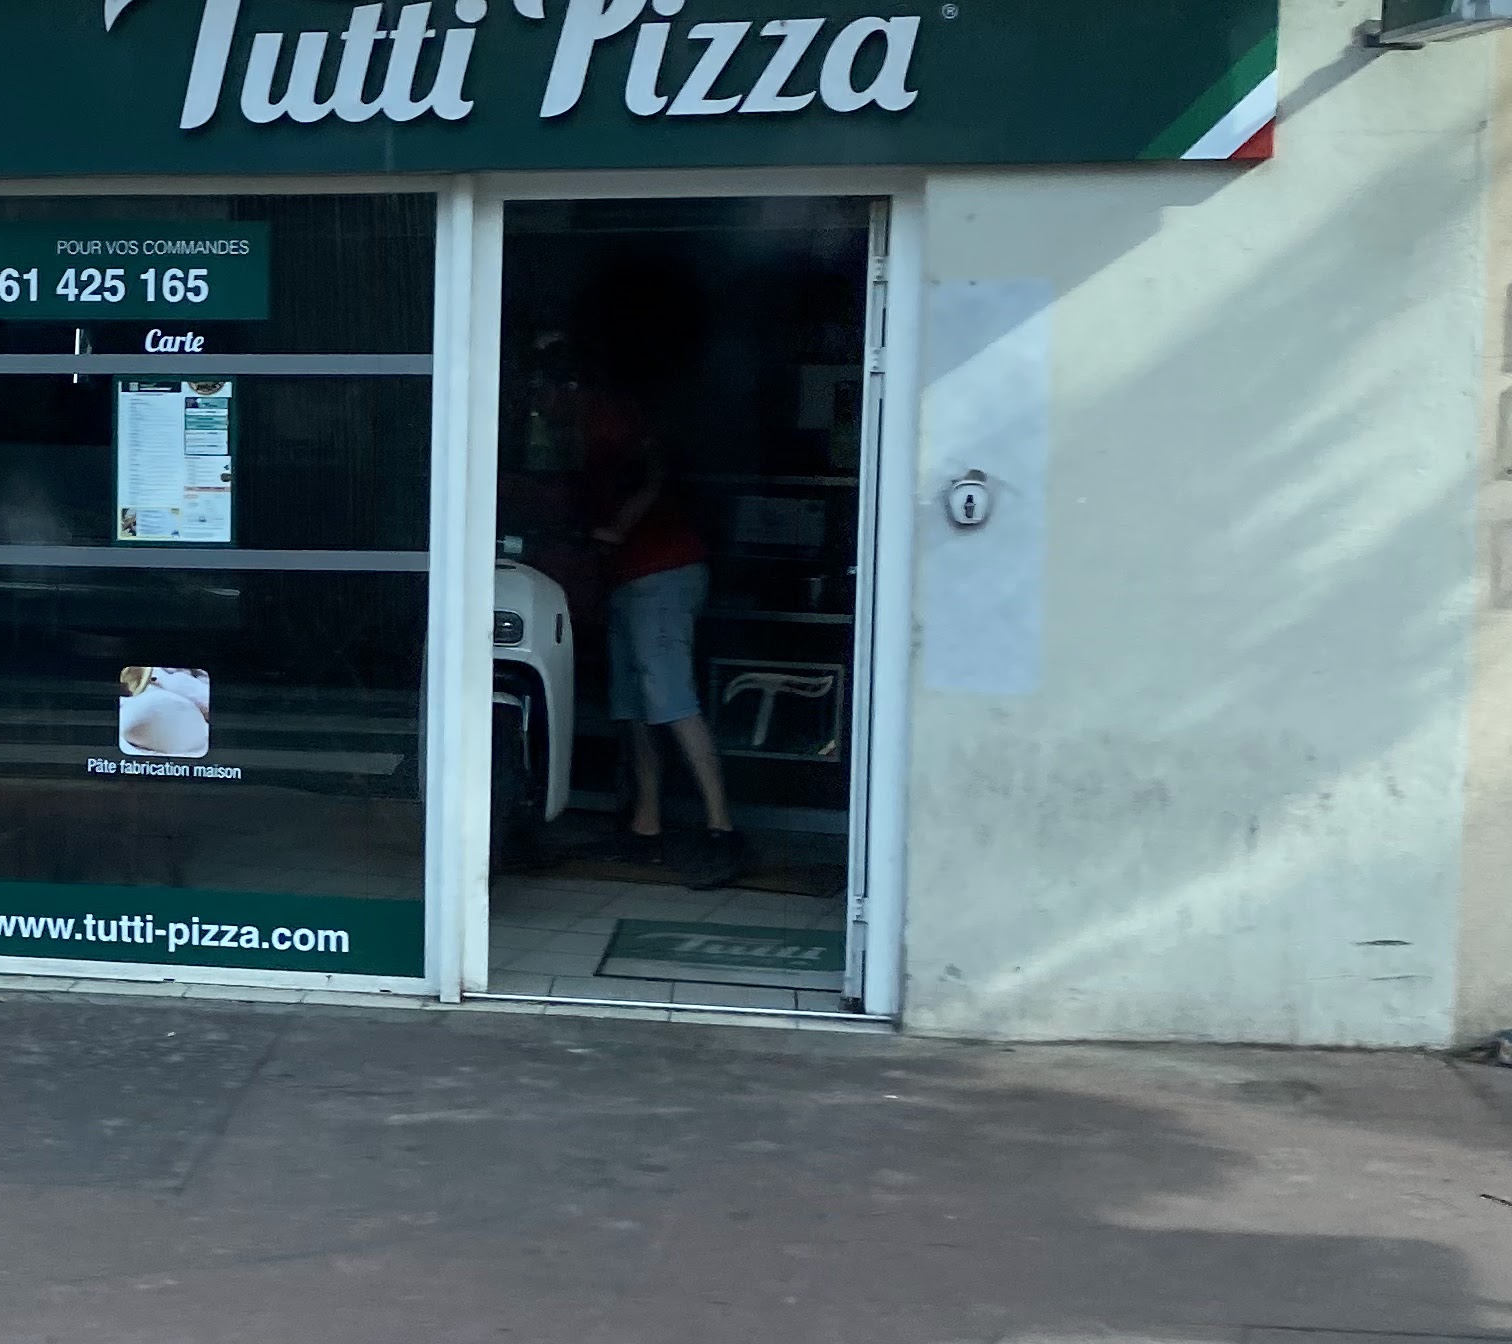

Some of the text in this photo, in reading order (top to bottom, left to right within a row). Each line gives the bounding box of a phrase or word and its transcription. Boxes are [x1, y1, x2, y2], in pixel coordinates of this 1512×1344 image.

[56, 240, 250, 256] POUR VOS COMMANDES
[55, 267, 127, 303] 425
[139, 267, 210, 304] 165
[144, 328, 205, 353] Carte
[87, 758, 242, 780] Pâte fabrication maison
